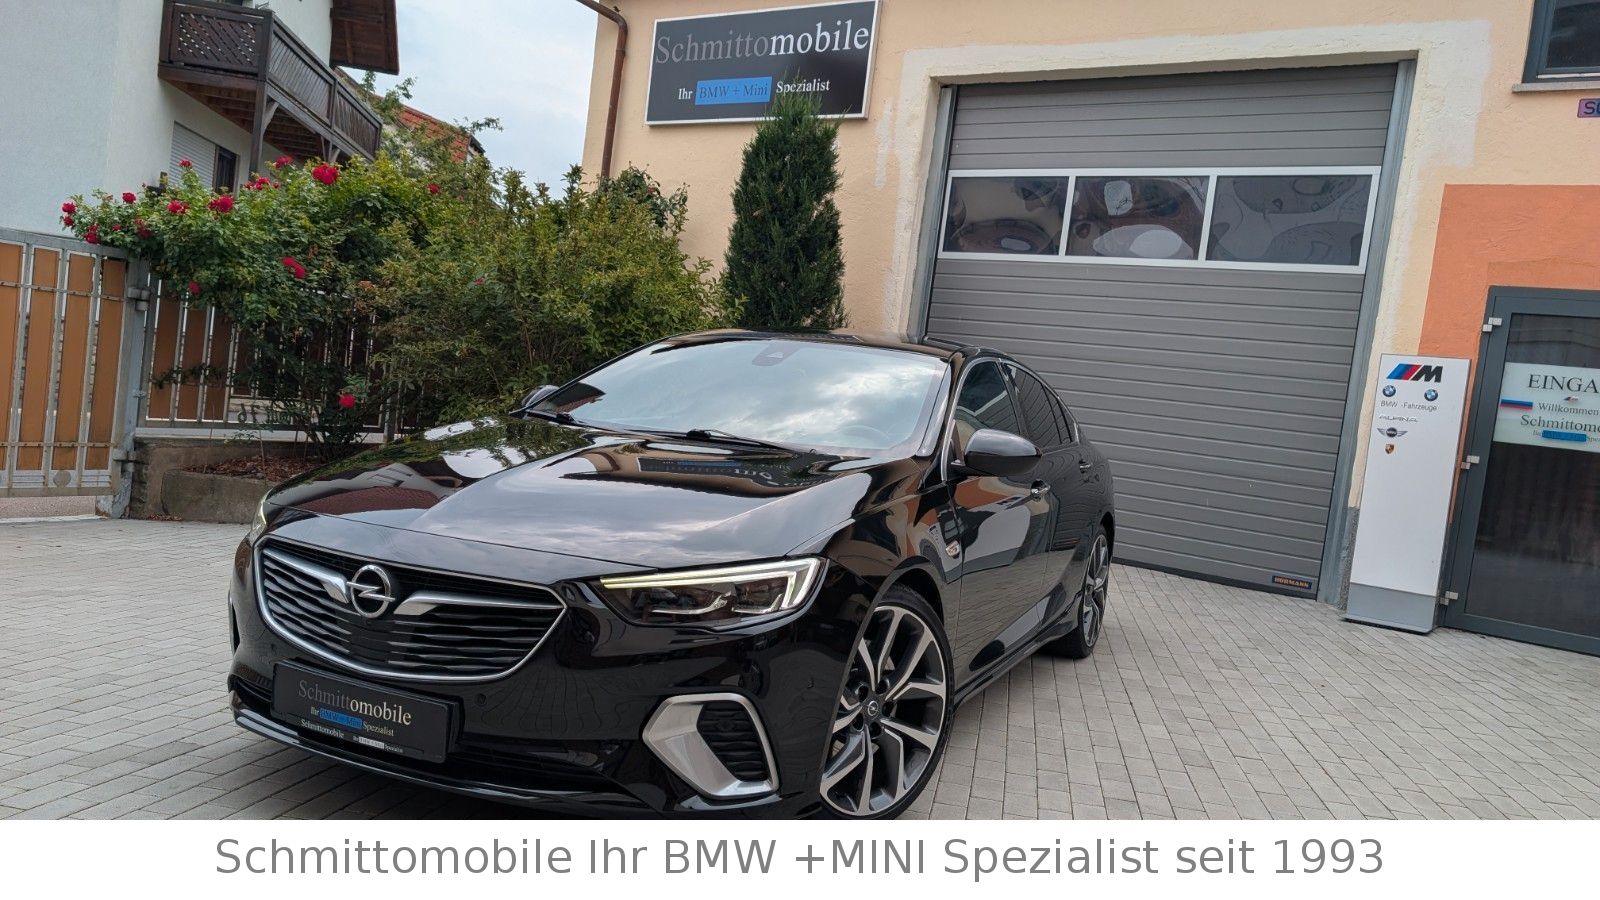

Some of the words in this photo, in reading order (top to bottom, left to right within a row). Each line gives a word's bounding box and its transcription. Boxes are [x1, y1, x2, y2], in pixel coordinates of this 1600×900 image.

[656, 19, 869, 64] Schmittomobile
[678, 88, 694, 100] Ihr
[700, 86, 729, 99] BMW
[743, 83, 768, 97] Mini
[775, 79, 831, 96] Spezialist
[1538, 402, 1599, 416] Willkommen
[298, 679, 412, 726] Schmittomobile
[363, 721, 394, 737] Spezialist
